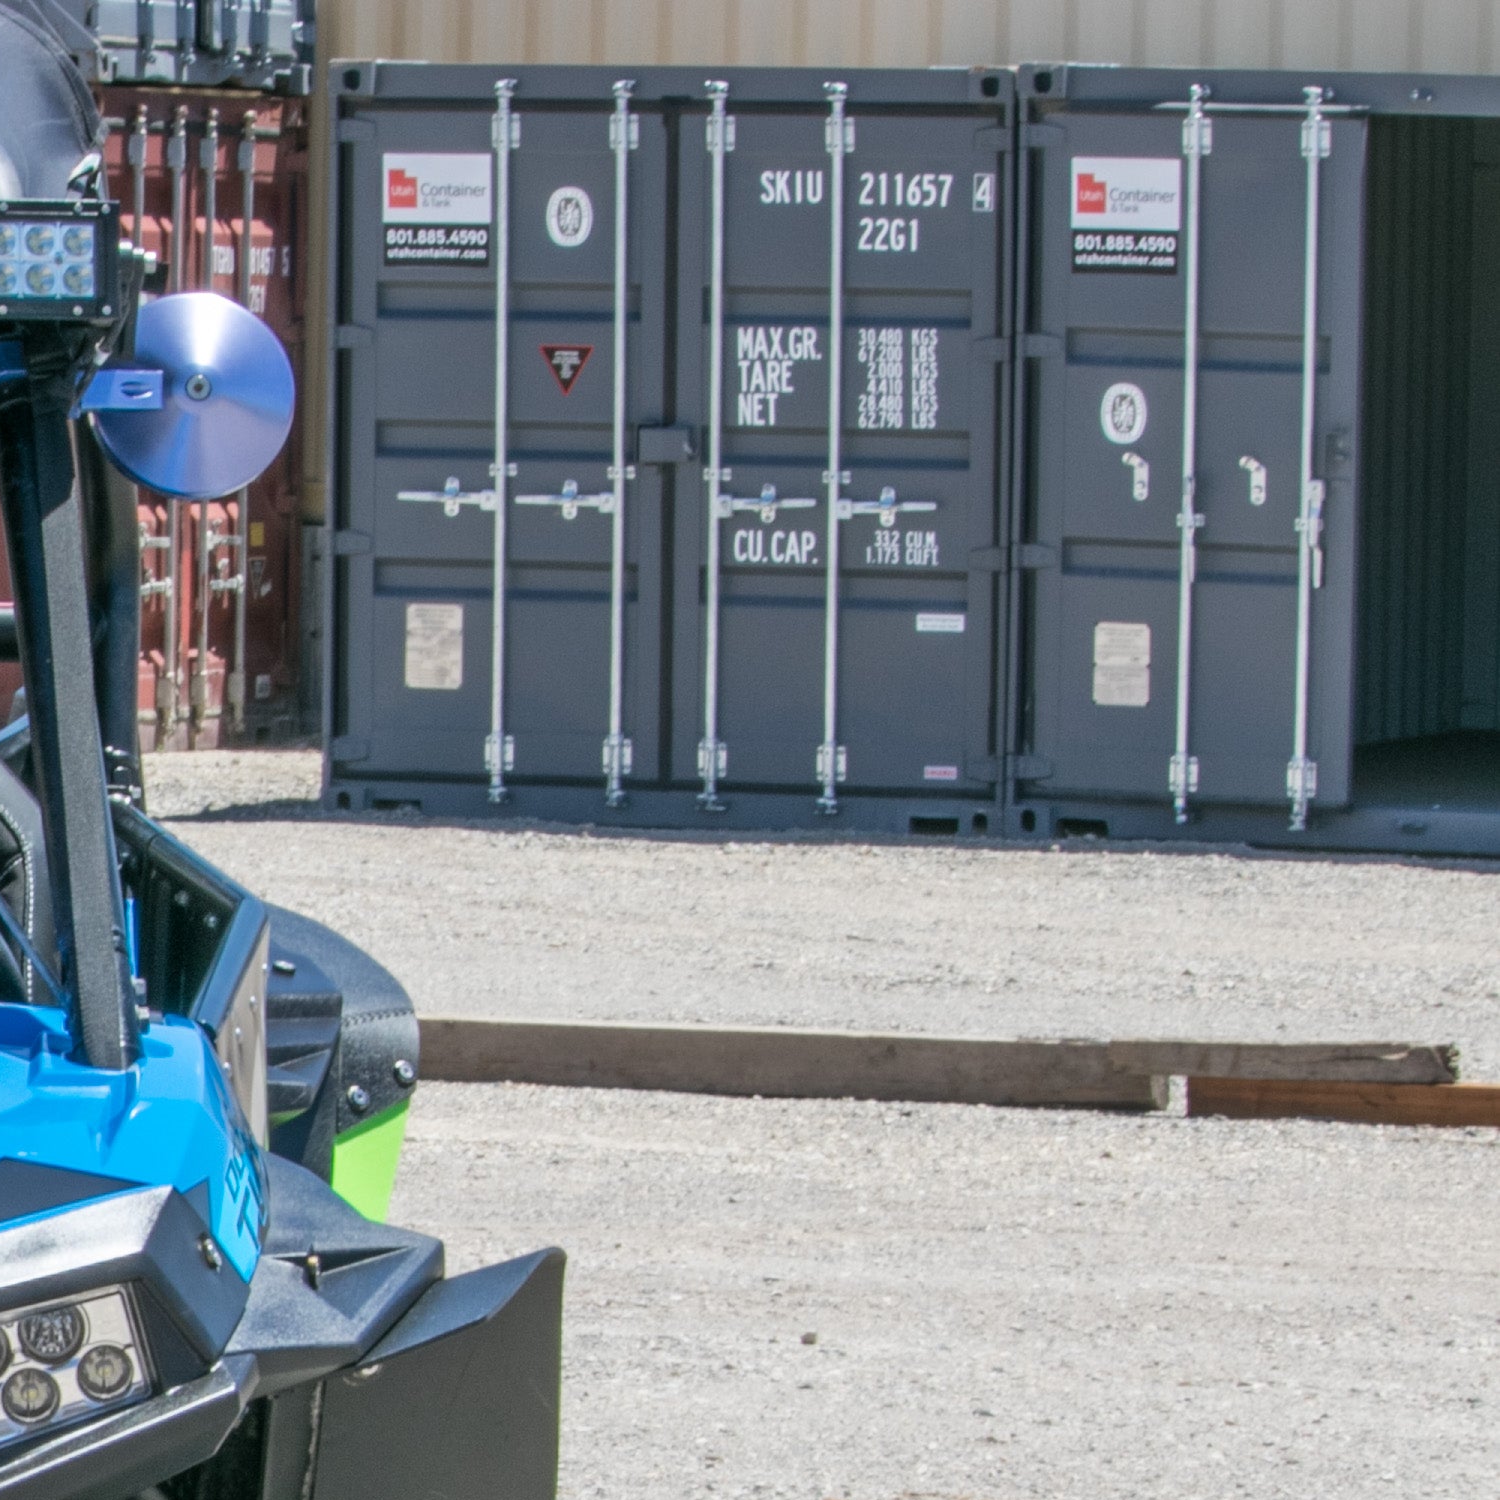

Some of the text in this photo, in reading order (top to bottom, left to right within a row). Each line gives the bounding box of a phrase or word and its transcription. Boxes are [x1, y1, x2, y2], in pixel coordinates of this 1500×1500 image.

[421, 183, 487, 197] Container
[760, 170, 994, 212] SKIU 211657 4
[1109, 188, 1176, 203] Container
[386, 229, 487, 245] 801.885.4590
[858, 217, 919, 252] 22G1
[1074, 234, 1176, 252] 801.885.4590
[387, 247, 487, 259] utahcontainer.com
[1075, 253, 1175, 266] utahcontainer.com
[737, 327, 822, 360] MAX.GR.
[911, 328, 938, 346] KGS
[911, 345, 936, 363] LBS
[738, 360, 794, 393] TARE
[911, 362, 938, 379] KGS
[911, 378, 936, 395] LBS
[737, 393, 779, 426] NET
[911, 394, 938, 412] KGS
[911, 411, 936, 430] LBS
[733, 529, 819, 564] CU.CAP.
